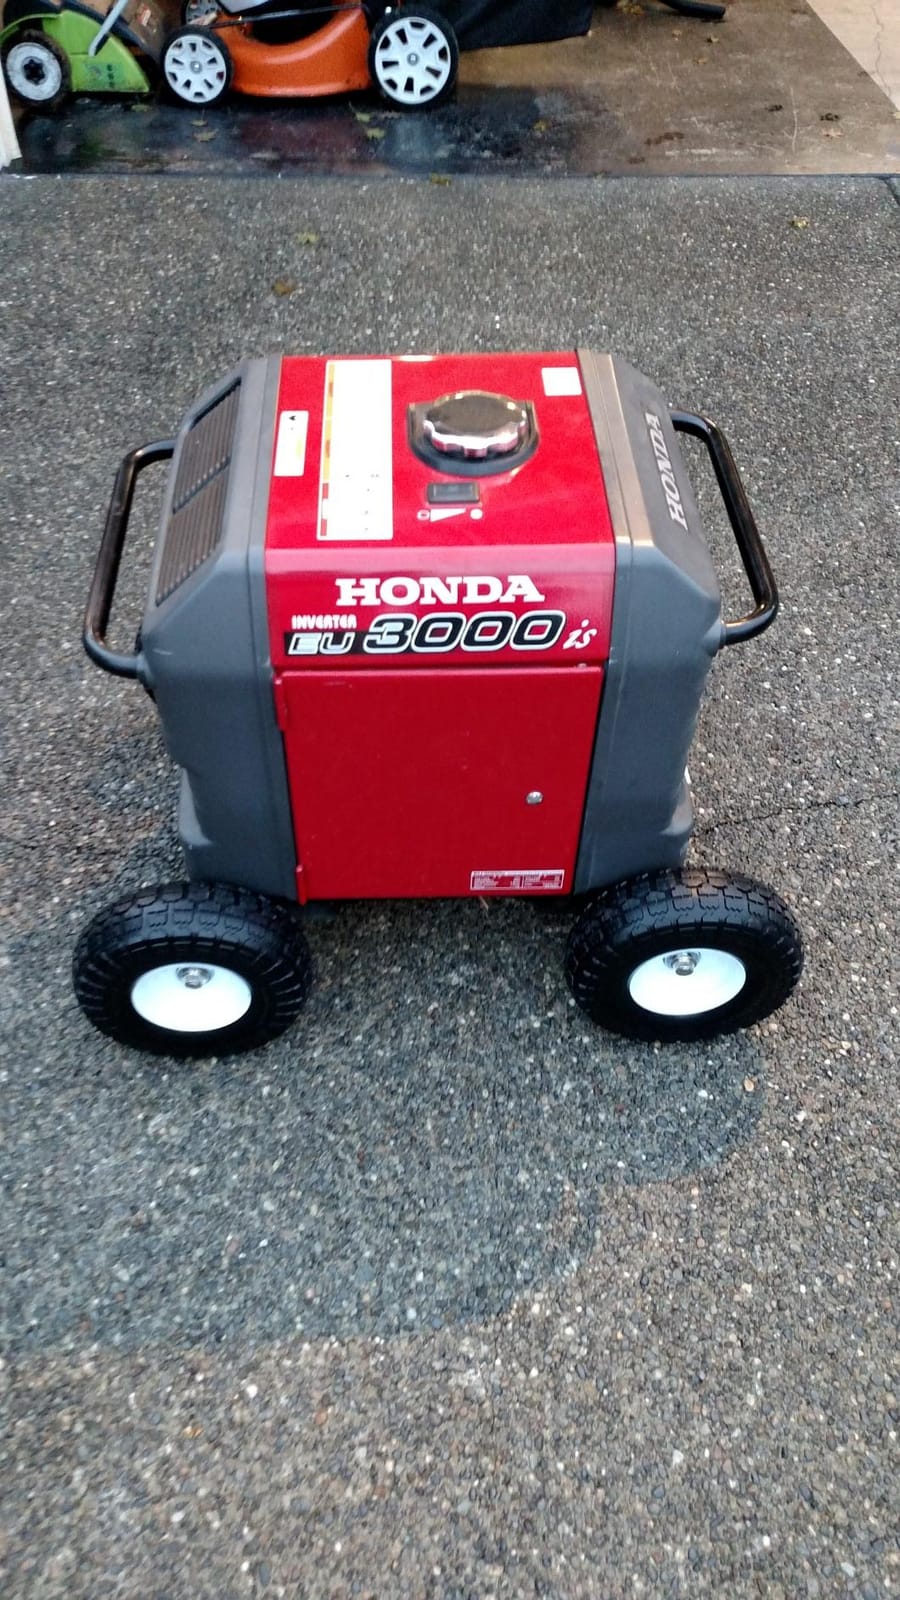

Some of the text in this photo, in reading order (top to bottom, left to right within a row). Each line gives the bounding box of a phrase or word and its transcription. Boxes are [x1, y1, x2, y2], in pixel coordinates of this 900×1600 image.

[645, 412, 688, 530] HONDA
[335, 575, 545, 606] HONDA
[291, 614, 357, 630] INVERTER
